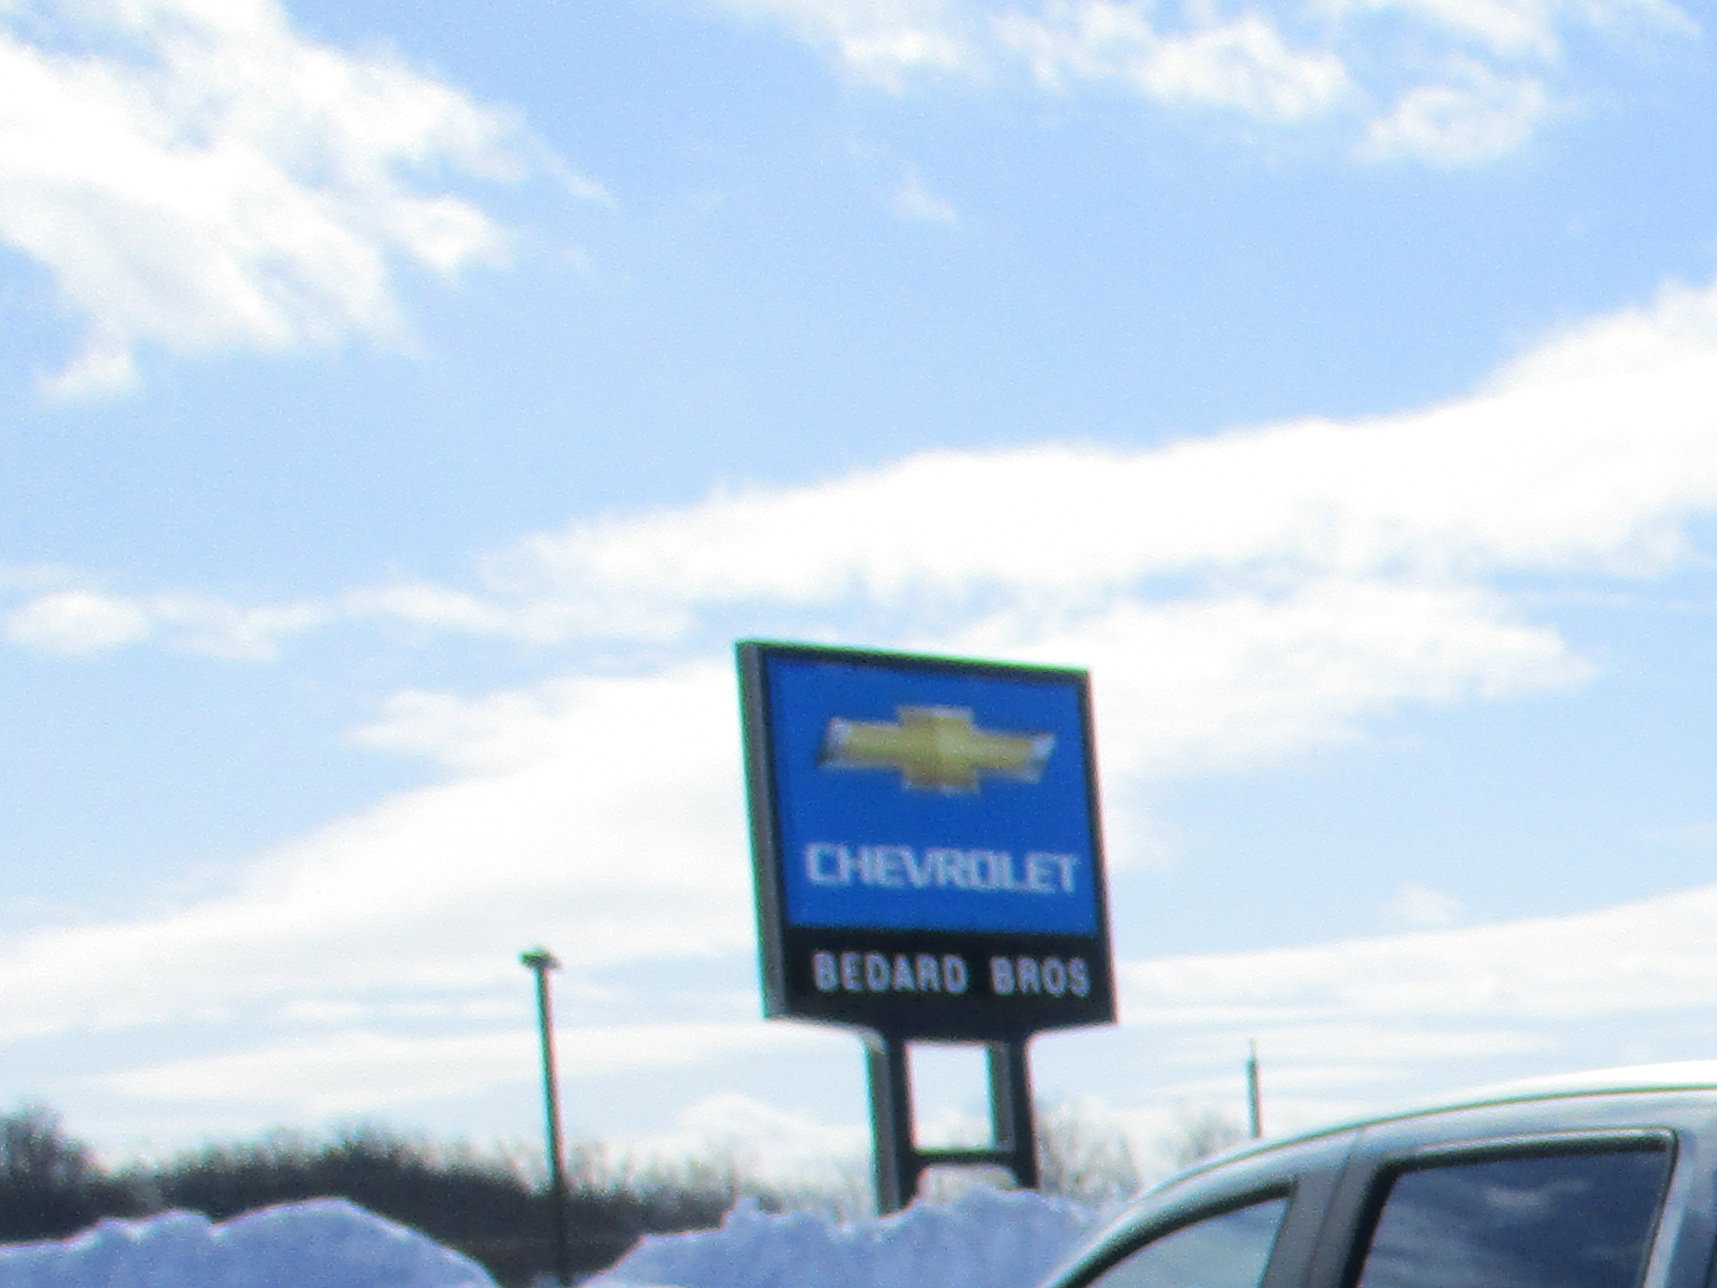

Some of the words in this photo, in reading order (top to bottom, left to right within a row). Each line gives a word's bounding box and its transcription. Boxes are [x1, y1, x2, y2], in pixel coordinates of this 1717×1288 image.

[806, 842, 1078, 893] CHEVROLET
[813, 951, 968, 994] BEDARD
[990, 956, 1091, 998] BROS
